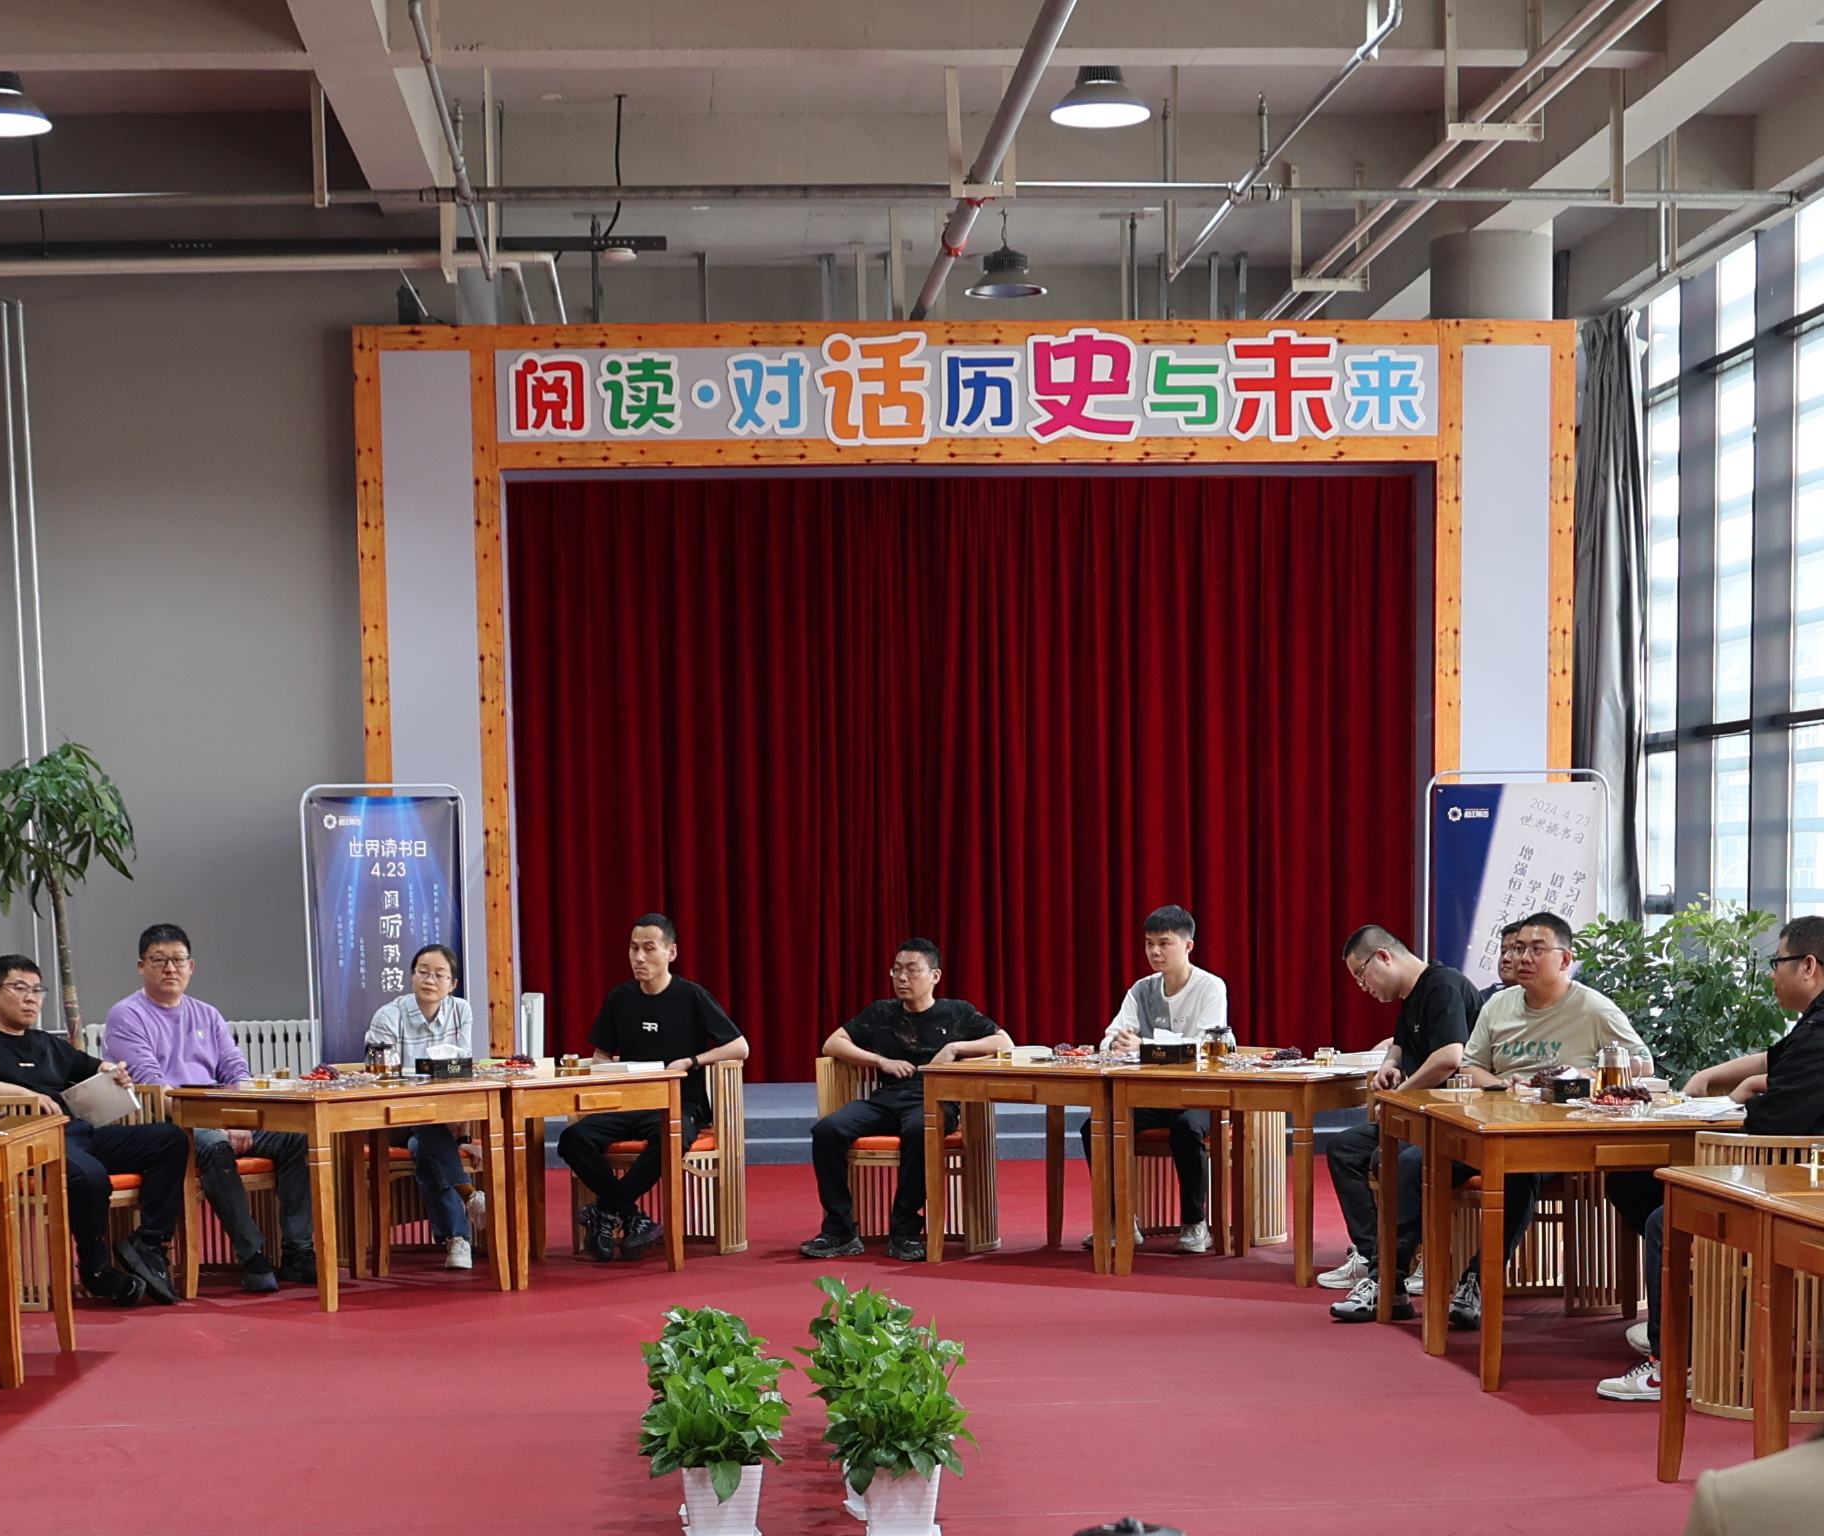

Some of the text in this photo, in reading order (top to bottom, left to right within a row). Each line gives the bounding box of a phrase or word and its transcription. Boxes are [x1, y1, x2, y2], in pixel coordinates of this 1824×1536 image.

[1519, 814, 1585, 844] 世界读书日
[348, 836, 427, 858] 世界读书日
[371, 861, 407, 877] 4.23
[379, 890, 405, 992] 倾听科技
[1501, 1040, 1563, 1057] LUCKY
